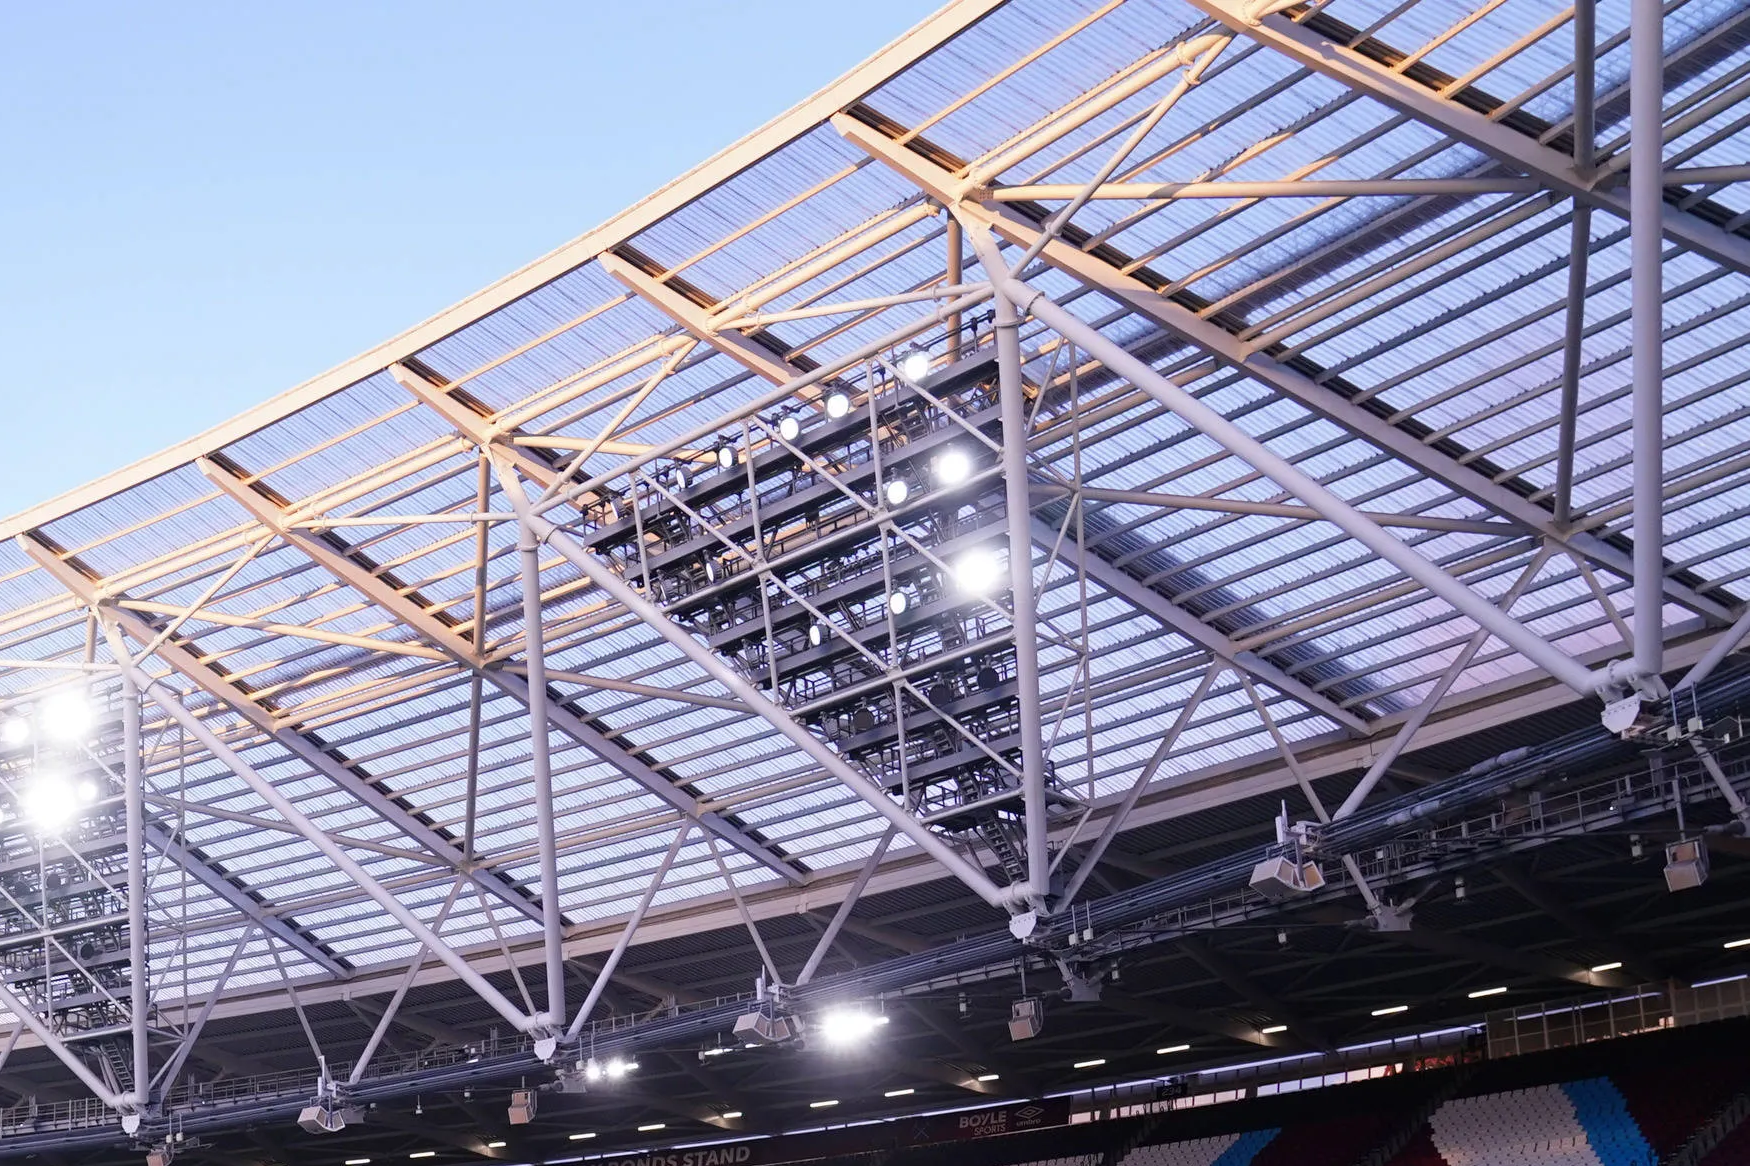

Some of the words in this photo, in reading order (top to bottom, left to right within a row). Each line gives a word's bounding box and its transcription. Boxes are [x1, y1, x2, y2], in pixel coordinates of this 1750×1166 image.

[959, 1110, 1008, 1129] BOYLE
[1016, 1118, 1042, 1127] umbro
[974, 1123, 1007, 1136] SPORTS
